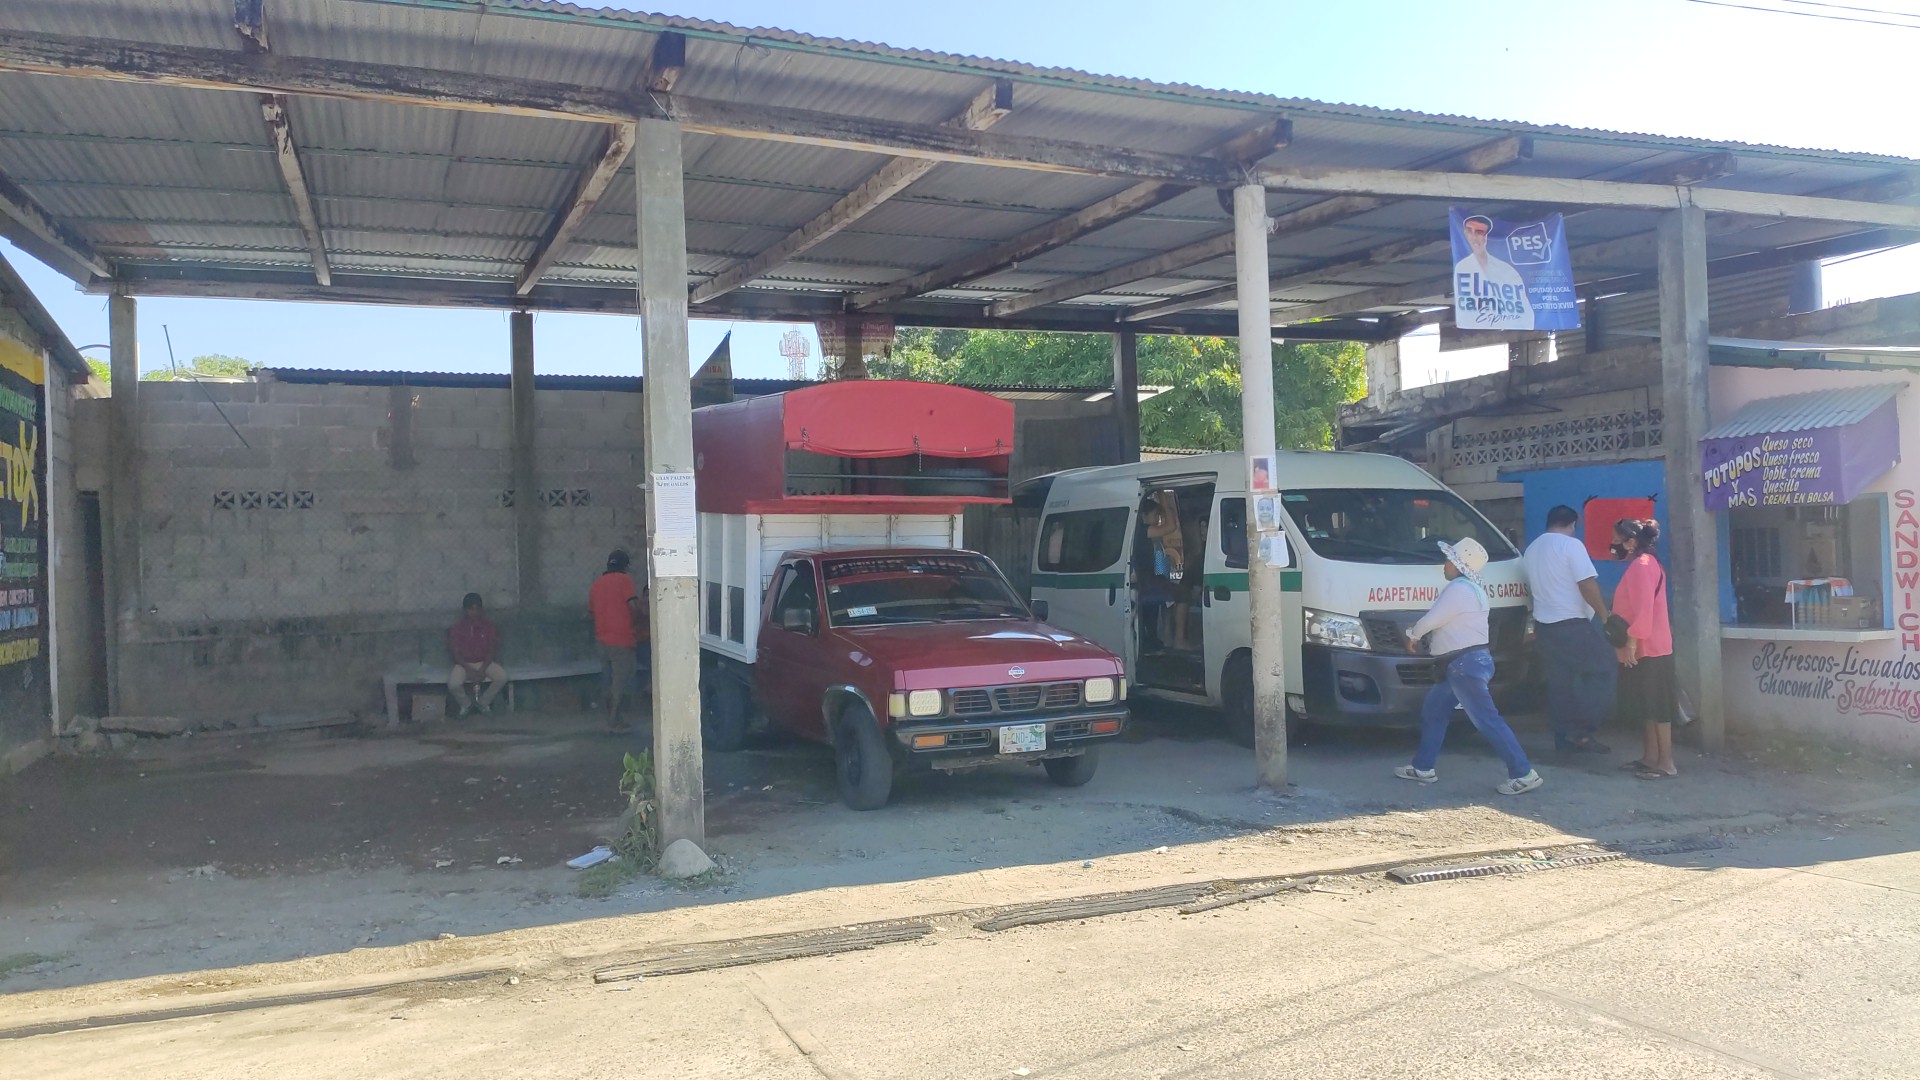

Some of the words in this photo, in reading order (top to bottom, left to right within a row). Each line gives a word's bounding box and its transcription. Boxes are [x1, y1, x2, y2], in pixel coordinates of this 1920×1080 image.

[1511, 236, 1543, 250] PES
[1457, 273, 1524, 300] Elmer
[1458, 297, 1525, 314] campos
[1762, 436, 1789, 452] Queso
[1791, 437, 1813, 450] seco
[1762, 452, 1788, 467] Queso
[1788, 450, 1820, 468] fresco
[1705, 447, 1761, 493] TOTOPOS
[1762, 465, 1787, 480] Doble
[1790, 466, 1822, 479] crema
[1731, 480, 1740, 493] Y
[1762, 479, 1800, 494] Quesillo
[1728, 488, 1757, 508] MAS
[1763, 493, 1791, 505] CREMA
[1793, 493, 1806, 503] EN
[1807, 491, 1834, 503] BOLSA
[1895, 489, 1920, 652] SANDWICH
[1368, 587, 1439, 602] ACAPETAHUA
[1497, 583, 1528, 598] GARZAS
[1835, 646, 1920, 681] Licuados
